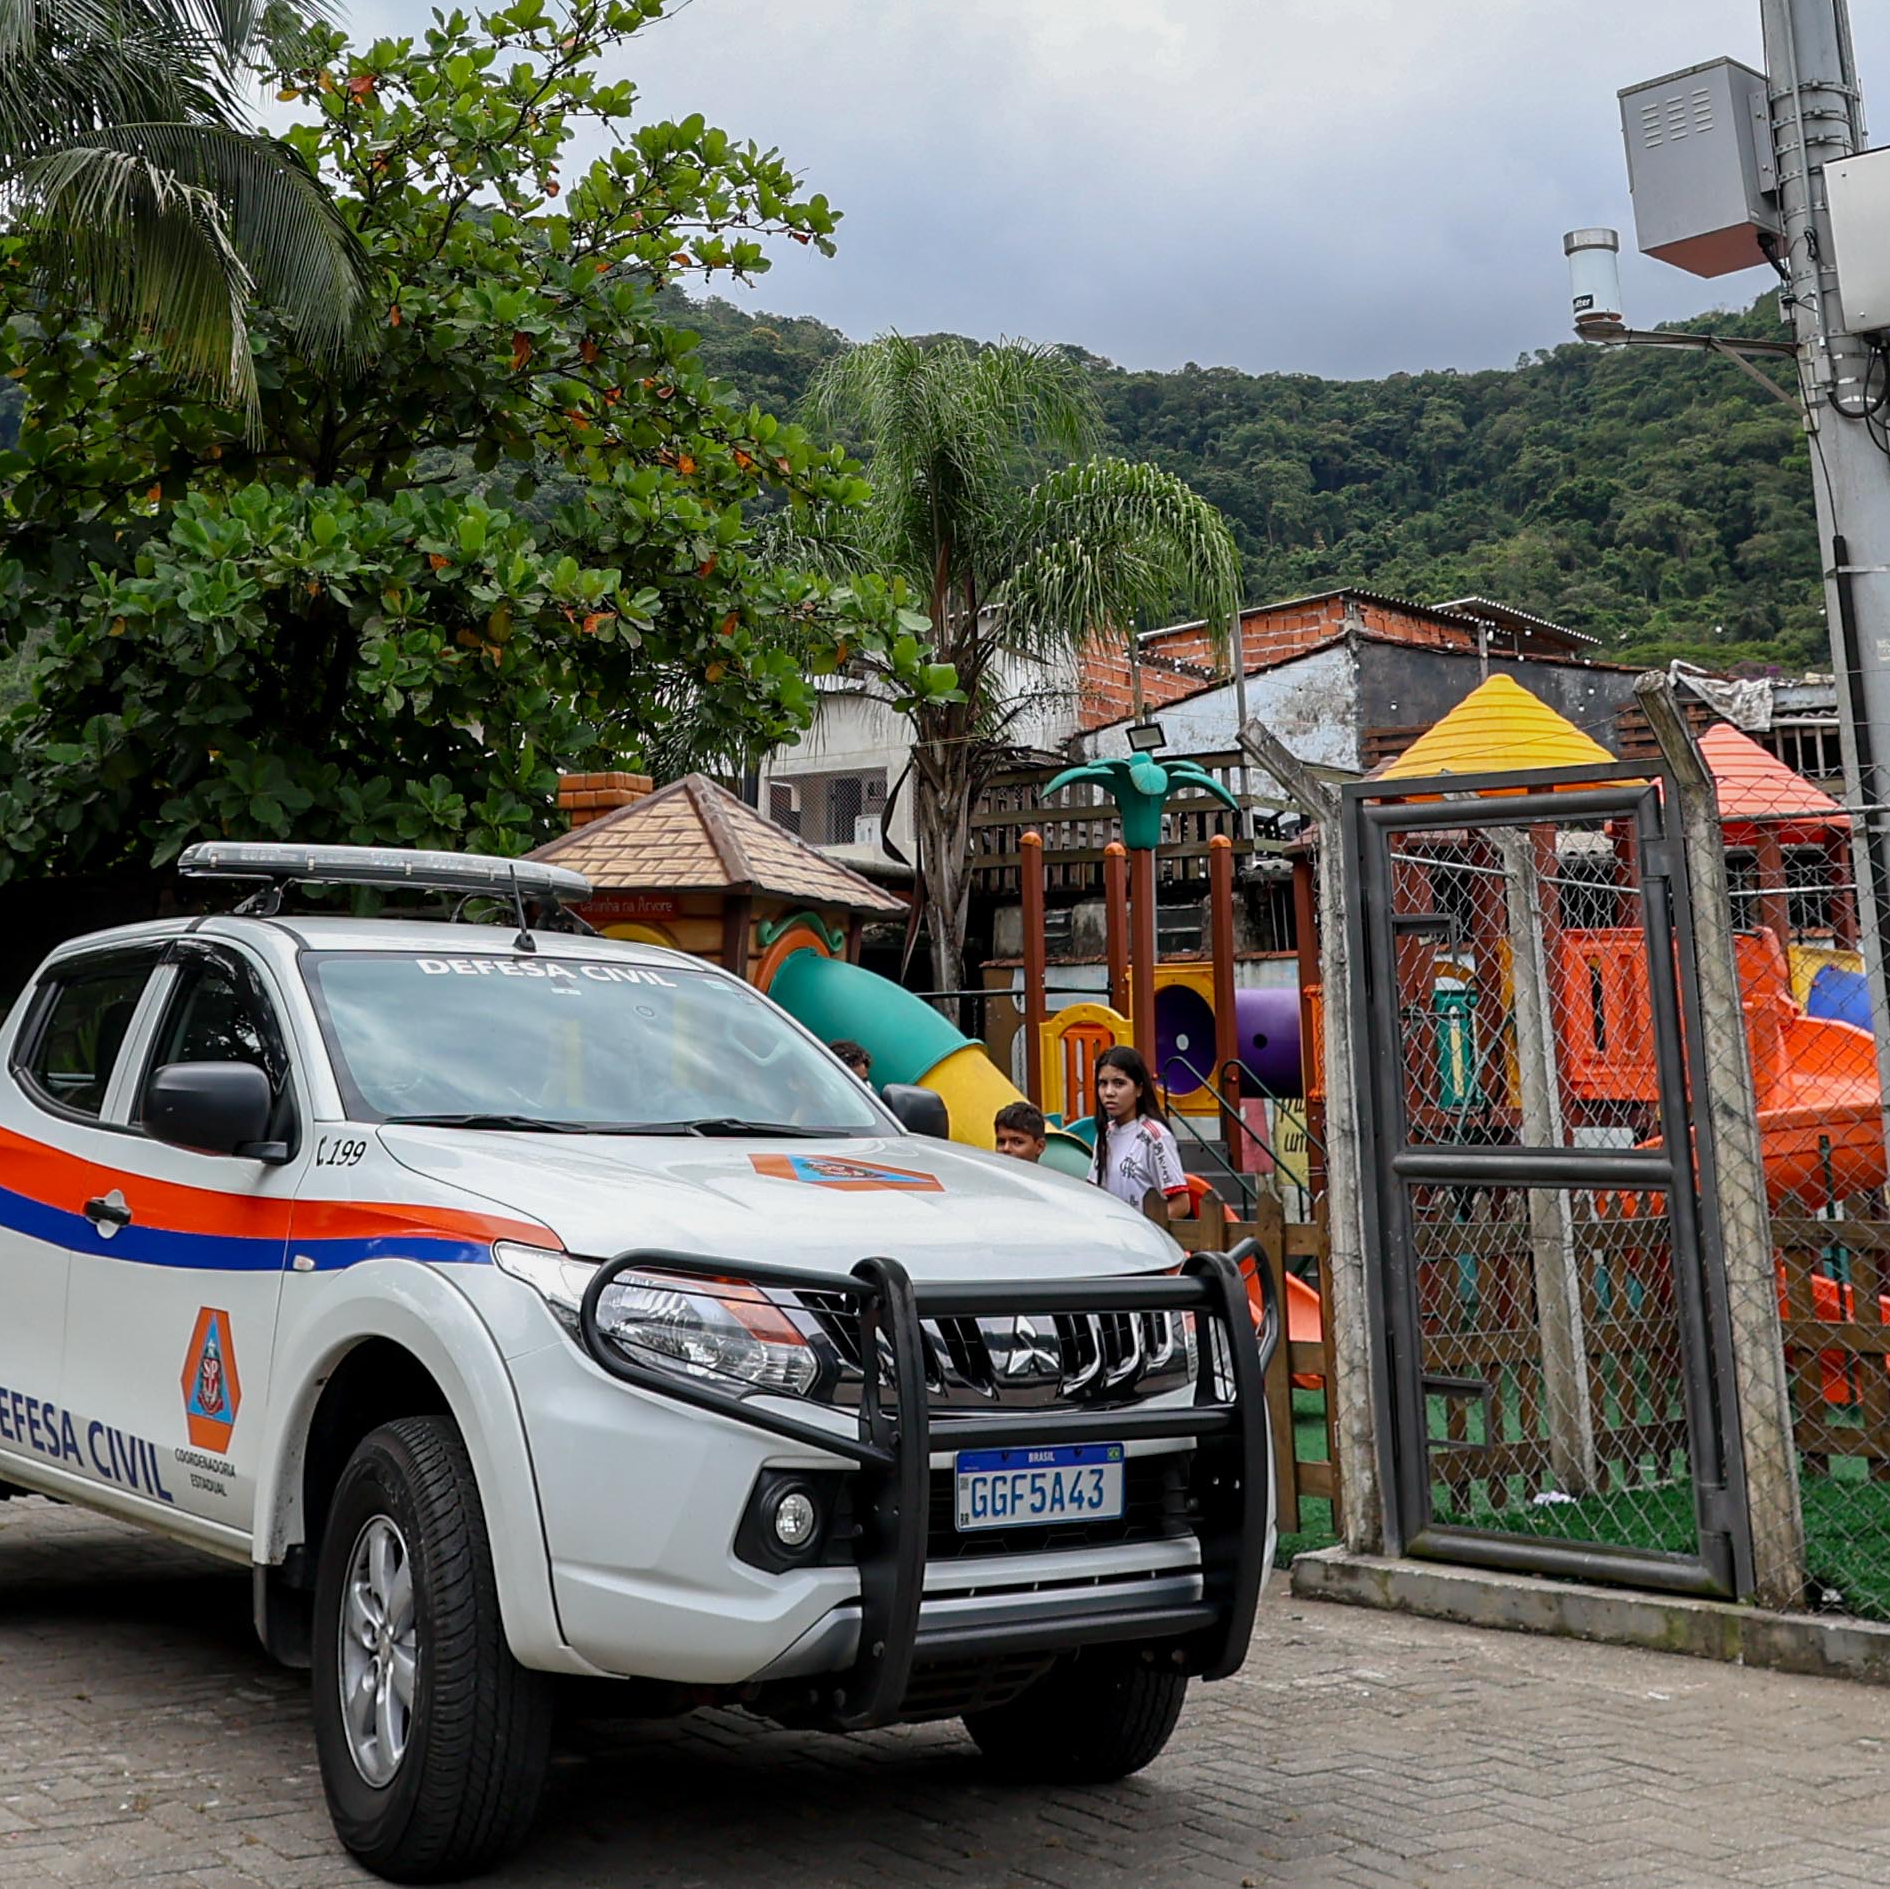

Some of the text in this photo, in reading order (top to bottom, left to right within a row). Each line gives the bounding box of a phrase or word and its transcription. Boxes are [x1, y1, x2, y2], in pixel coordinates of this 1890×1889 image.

[416, 959, 678, 988] DEFESA CIVIL
[326, 1139, 367, 1167] 199
[88, 1420, 174, 1503] CIVIL
[175, 1447, 236, 1479] COORDENADORIA
[1028, 1451, 1055, 1463] BRASIL
[190, 1473, 227, 1497] ESTADUAL
[971, 1468, 1104, 1519] GGF5A43
